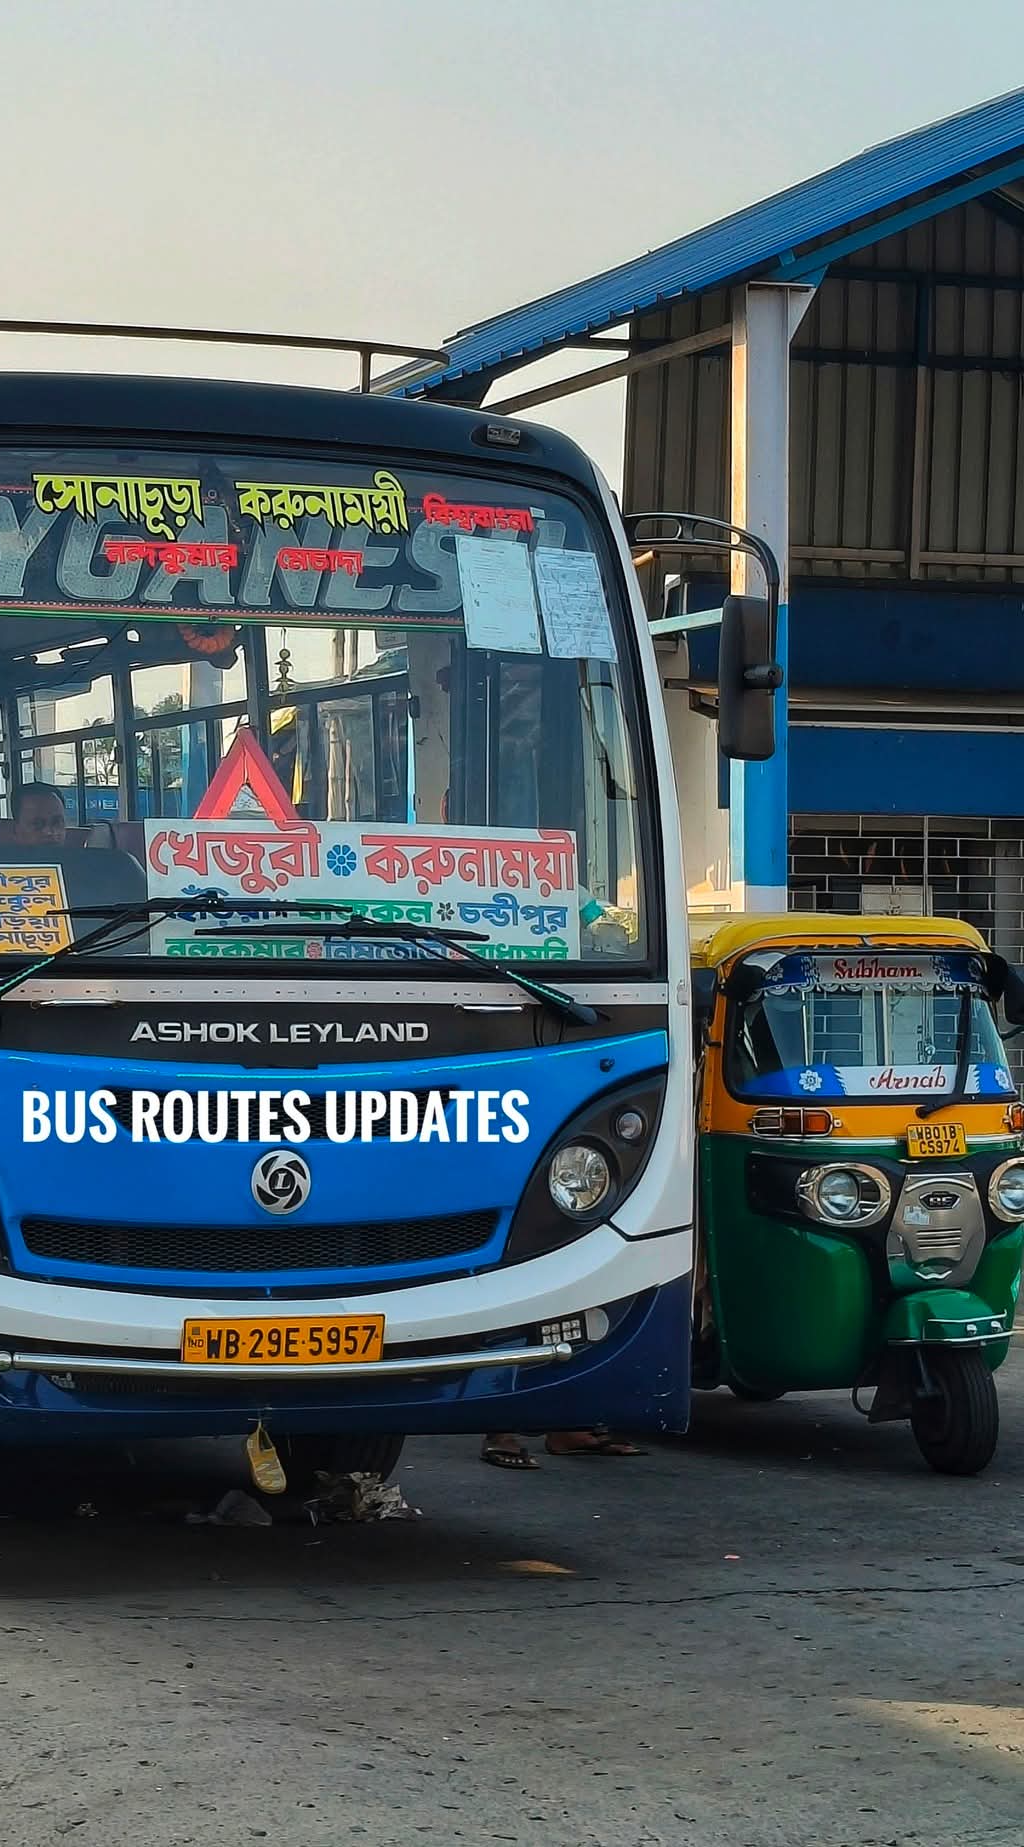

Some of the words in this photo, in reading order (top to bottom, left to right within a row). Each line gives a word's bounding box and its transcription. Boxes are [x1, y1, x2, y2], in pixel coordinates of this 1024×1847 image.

[149, 821, 322, 894] খেজুরী
[361, 829, 575, 898] করুনাময়ী
[129, 1021, 262, 1044] ASHOK
[269, 1021, 430, 1044] LEYLAND
[869, 1066, 947, 1090] Arnab
